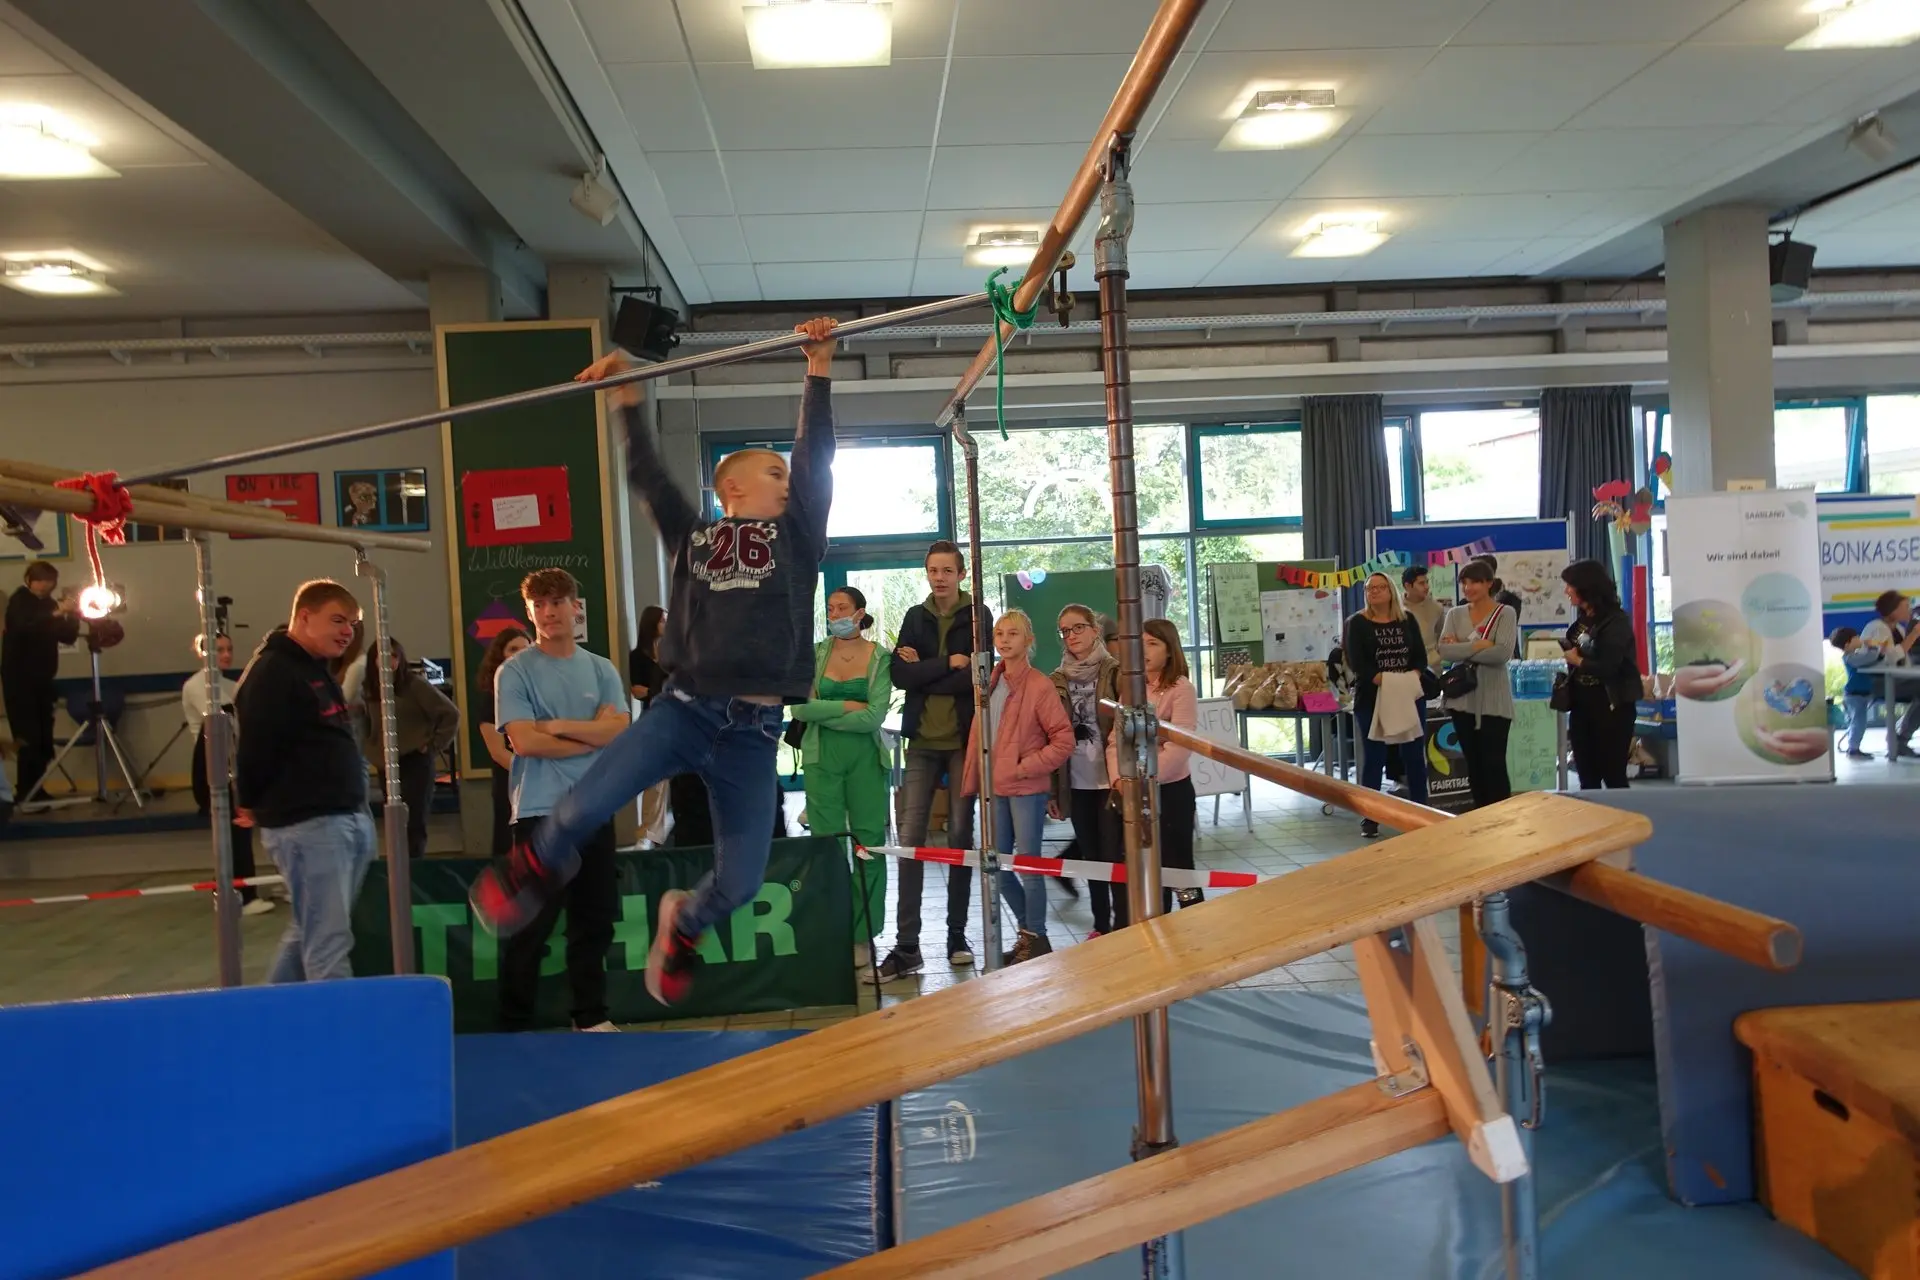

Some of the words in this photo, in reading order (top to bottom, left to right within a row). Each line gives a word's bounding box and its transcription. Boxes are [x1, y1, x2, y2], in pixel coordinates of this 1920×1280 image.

[468, 543, 590, 571] Willkommen
[706, 522, 772, 570] 26
[1706, 550, 1724, 562] Wir
[1727, 549, 1748, 561] sind
[1821, 536, 1920, 566] BONKASSE
[1375, 627, 1404, 637] LIVE
[1378, 636, 1405, 646] YOUR
[1196, 707, 1233, 733] NFO
